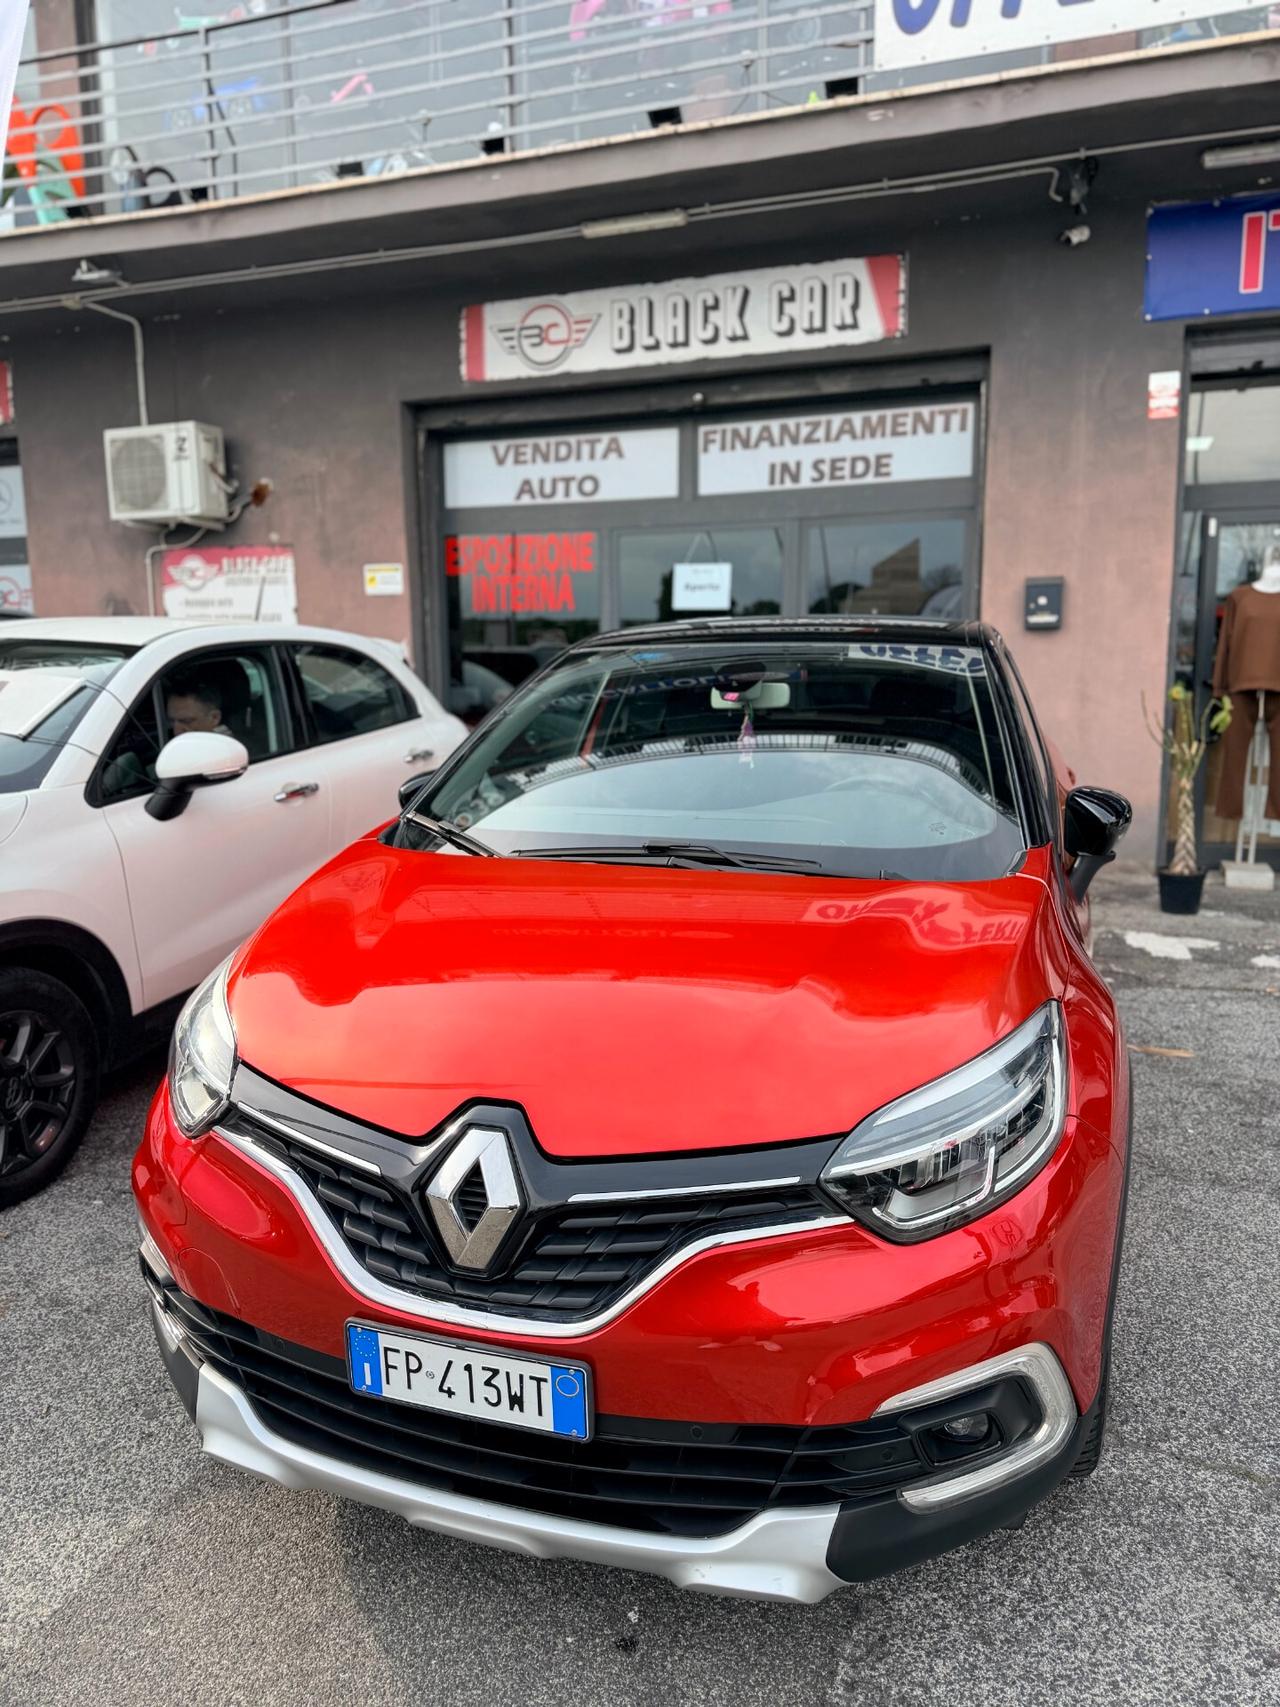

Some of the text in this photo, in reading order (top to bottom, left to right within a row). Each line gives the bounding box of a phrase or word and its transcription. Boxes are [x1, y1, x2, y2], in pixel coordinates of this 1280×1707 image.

[610, 285, 750, 354] BLACK
[768, 271, 860, 337] CAR
[702, 407, 969, 453] FINANZIAMENTI
[491, 436, 625, 466] VENDITA
[768, 453, 894, 486] IN SEDE
[515, 474, 601, 501] AUTO
[445, 532, 596, 576] ESPOSIZIONE
[471, 573, 576, 614] INTERNA
